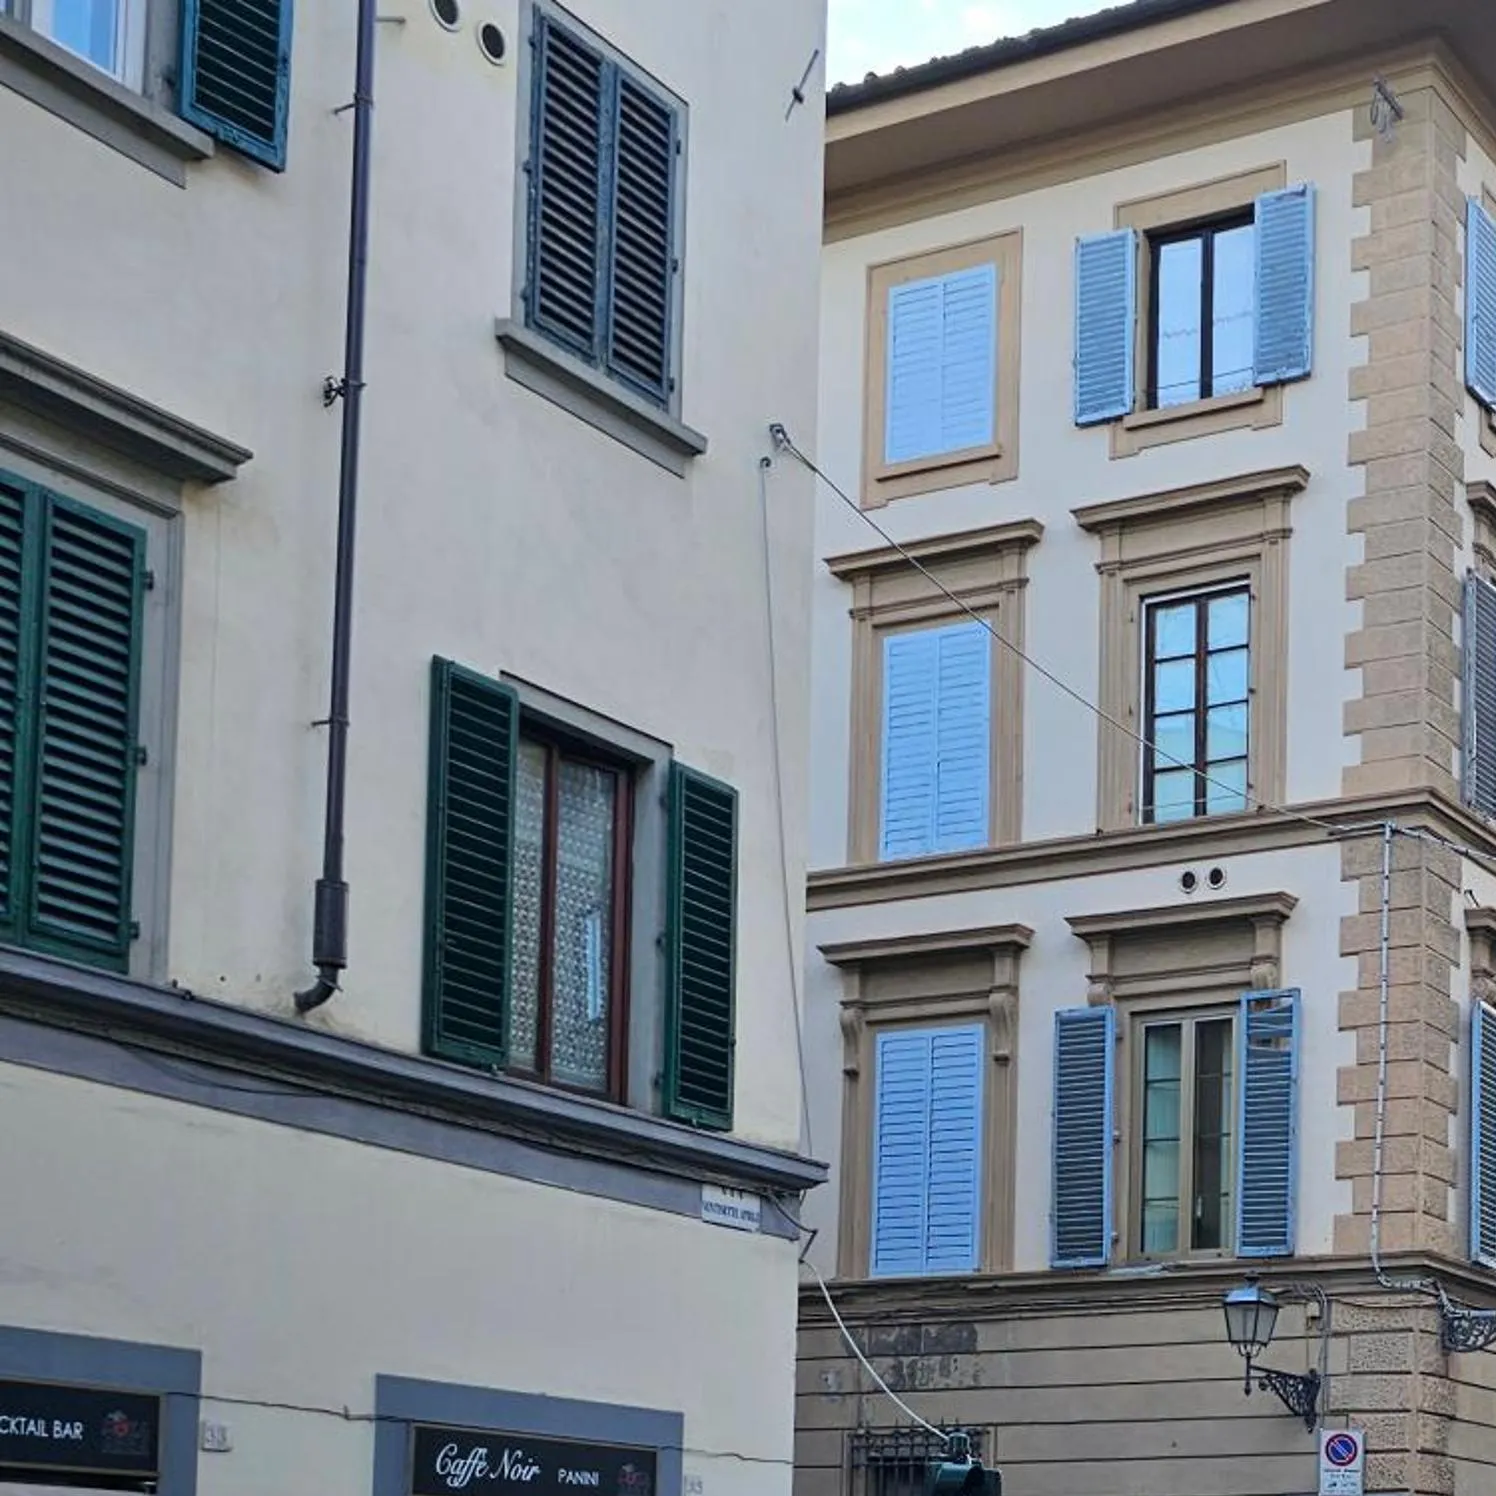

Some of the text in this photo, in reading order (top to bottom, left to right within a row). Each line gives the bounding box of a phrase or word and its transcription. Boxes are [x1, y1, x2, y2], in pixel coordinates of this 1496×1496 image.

[53, 1420, 83, 1440] BAR
[490, 1449, 541, 1481] Noir
[557, 1468, 599, 1486] PANINI
